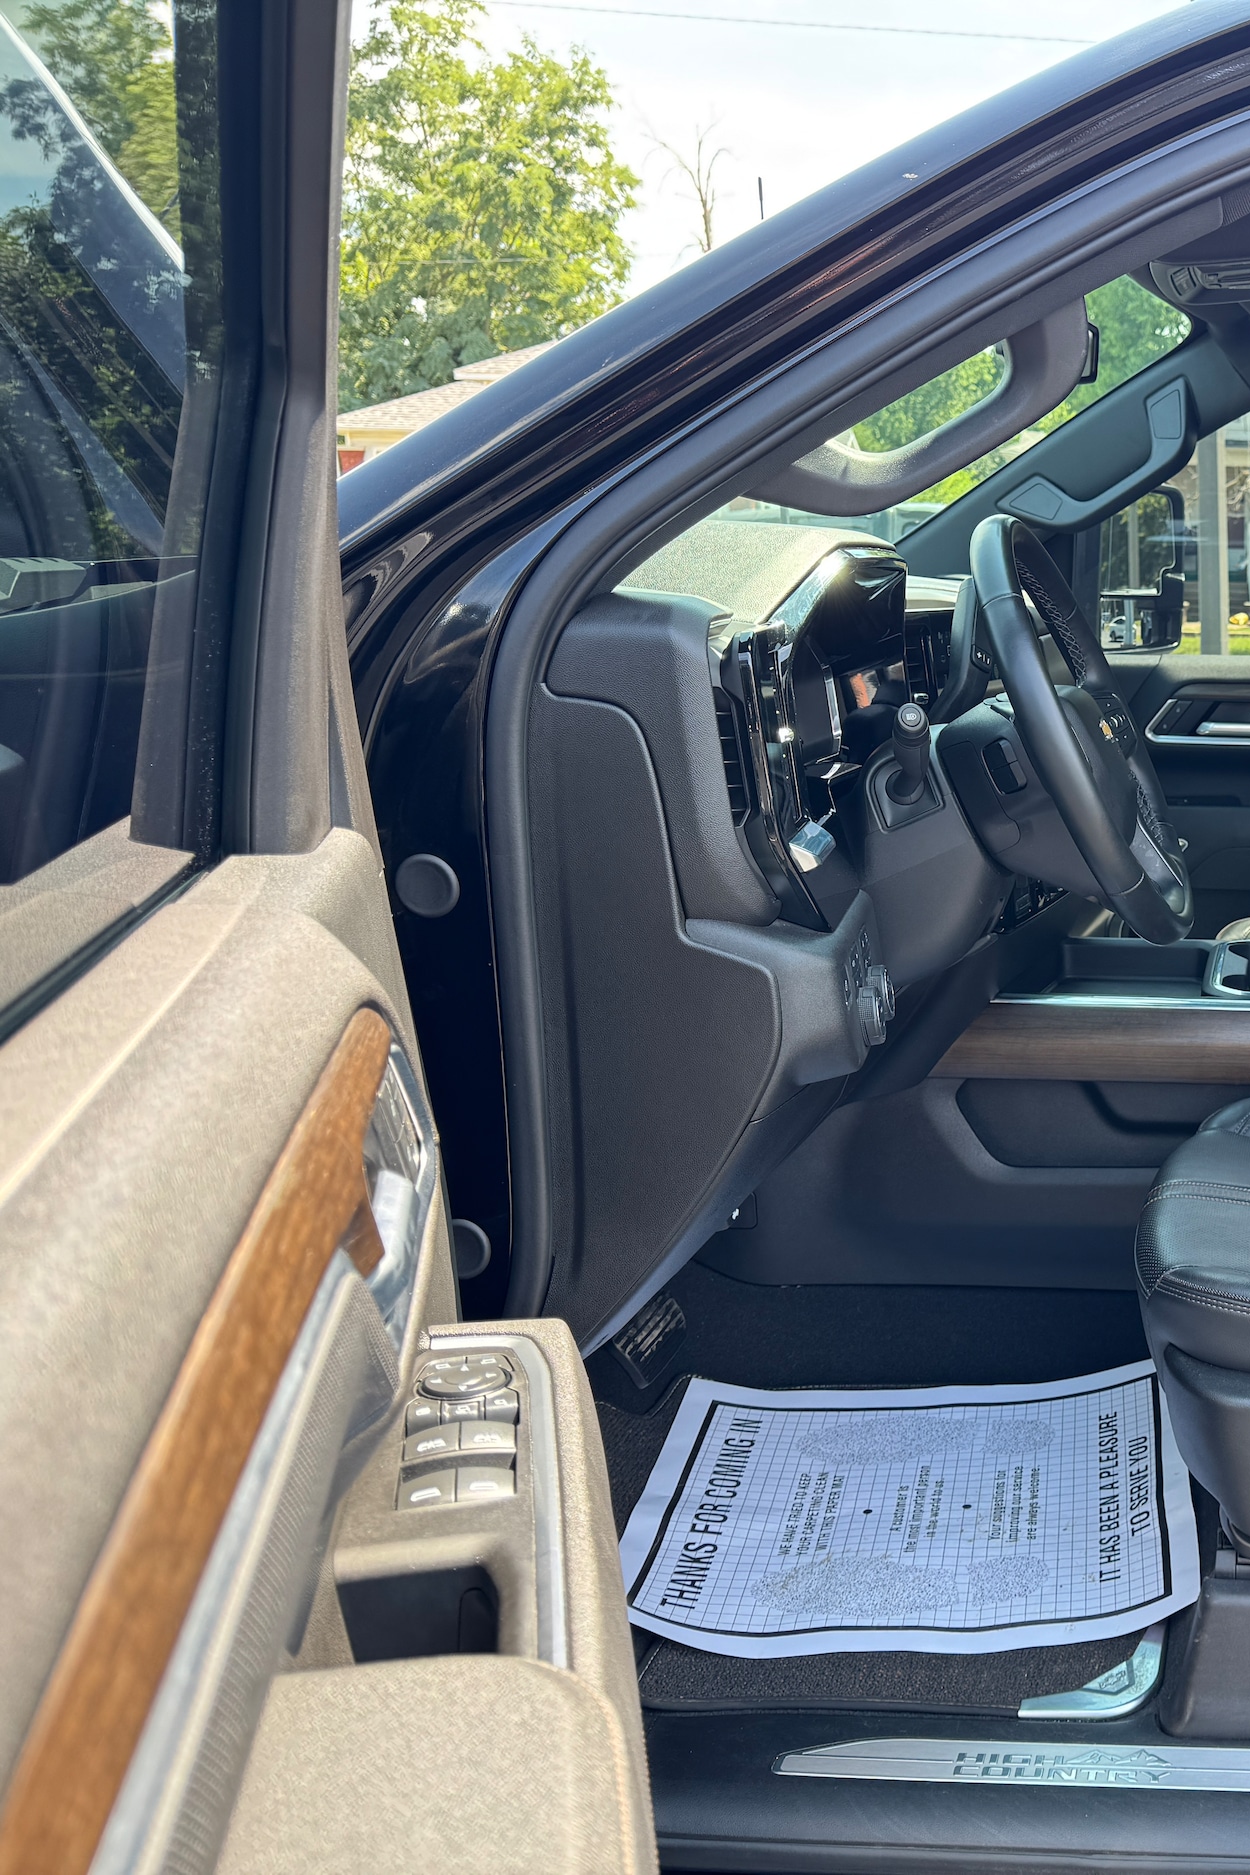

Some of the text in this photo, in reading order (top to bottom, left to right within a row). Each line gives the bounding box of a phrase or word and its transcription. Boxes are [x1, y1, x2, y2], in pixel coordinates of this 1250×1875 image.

[659, 1417, 764, 1607] THANKS FOR COMING IN
[777, 1472, 811, 1555] WE HAVE TRIED TO KEEP
[796, 1471, 829, 1555] YOUR CARPETING CLEAN
[815, 1474, 845, 1550] WITH THIS PAPER MAT
[891, 1492, 908, 1524] customer
[904, 1465, 931, 1552] the most important person
[927, 1497, 942, 1518] world
[988, 1470, 1007, 1540] Your suggestions for
[1007, 1465, 1025, 1542] improving our service
[1026, 1501, 1041, 1525] always
[1096, 1411, 1124, 1581] IT HAS BEEN A PLEASURE
[1126, 1435, 1154, 1535] TO SERVE YOU
[925, 1519, 939, 1529] the
[1025, 1527, 1040, 1539] are
[952, 1765, 1171, 1784] COUNTRY
[957, 1752, 1064, 1767] HIGH
